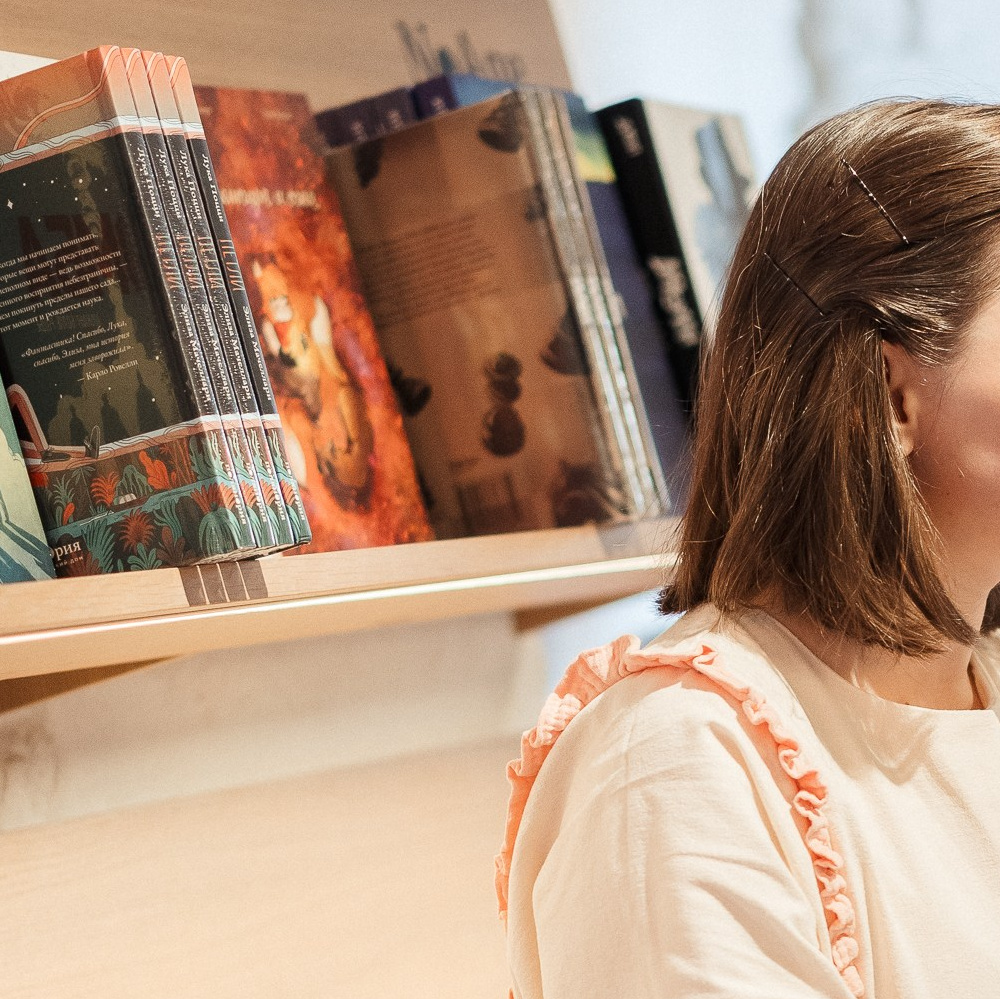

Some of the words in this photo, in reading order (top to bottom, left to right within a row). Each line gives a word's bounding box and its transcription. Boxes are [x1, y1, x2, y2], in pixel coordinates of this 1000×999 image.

[17, 254, 28, 263] мы
[29, 244, 62, 260] начинаем
[137, 147, 148, 176] Лука
[146, 178, 161, 218] Поцци
[180, 303, 194, 338] Элиза
[159, 149, 170, 177] Лука
[168, 180, 182, 218] Поцци
[201, 303, 214, 338] Элиза
[180, 150, 191, 178] Лука
[188, 181, 202, 219] Поцци
[221, 303, 235, 337] Элиза
[19, 265, 36, 276] вещи
[37, 258, 57, 272] могут
[58, 245, 99, 264] представать
[33, 274, 48, 284] виде
[59, 265, 74, 276] ведь
[74, 250, 121, 271] возможности
[24, 281, 64, 300] восприятия
[202, 154, 213, 181] Лука
[210, 184, 224, 222] Поцци
[242, 305, 255, 338] Элиза
[252, 341, 272, 401] Мачеллари
[11, 301, 43, 317] покинуть
[44, 294, 73, 311] пределы
[74, 284, 99, 296] нашего
[13, 316, 38, 330] момент
[46, 301, 82, 322] рождается
[76, 326, 106, 341] Спасибо,
[107, 319, 127, 331] Лука,
[33, 352, 60, 367] спасибо,
[62, 346, 84, 357] Элиза,
[101, 331, 130, 346] история
[69, 359, 86, 369] меня
[86, 367, 108, 381] Карло
[109, 358, 138, 373] Ровелли
